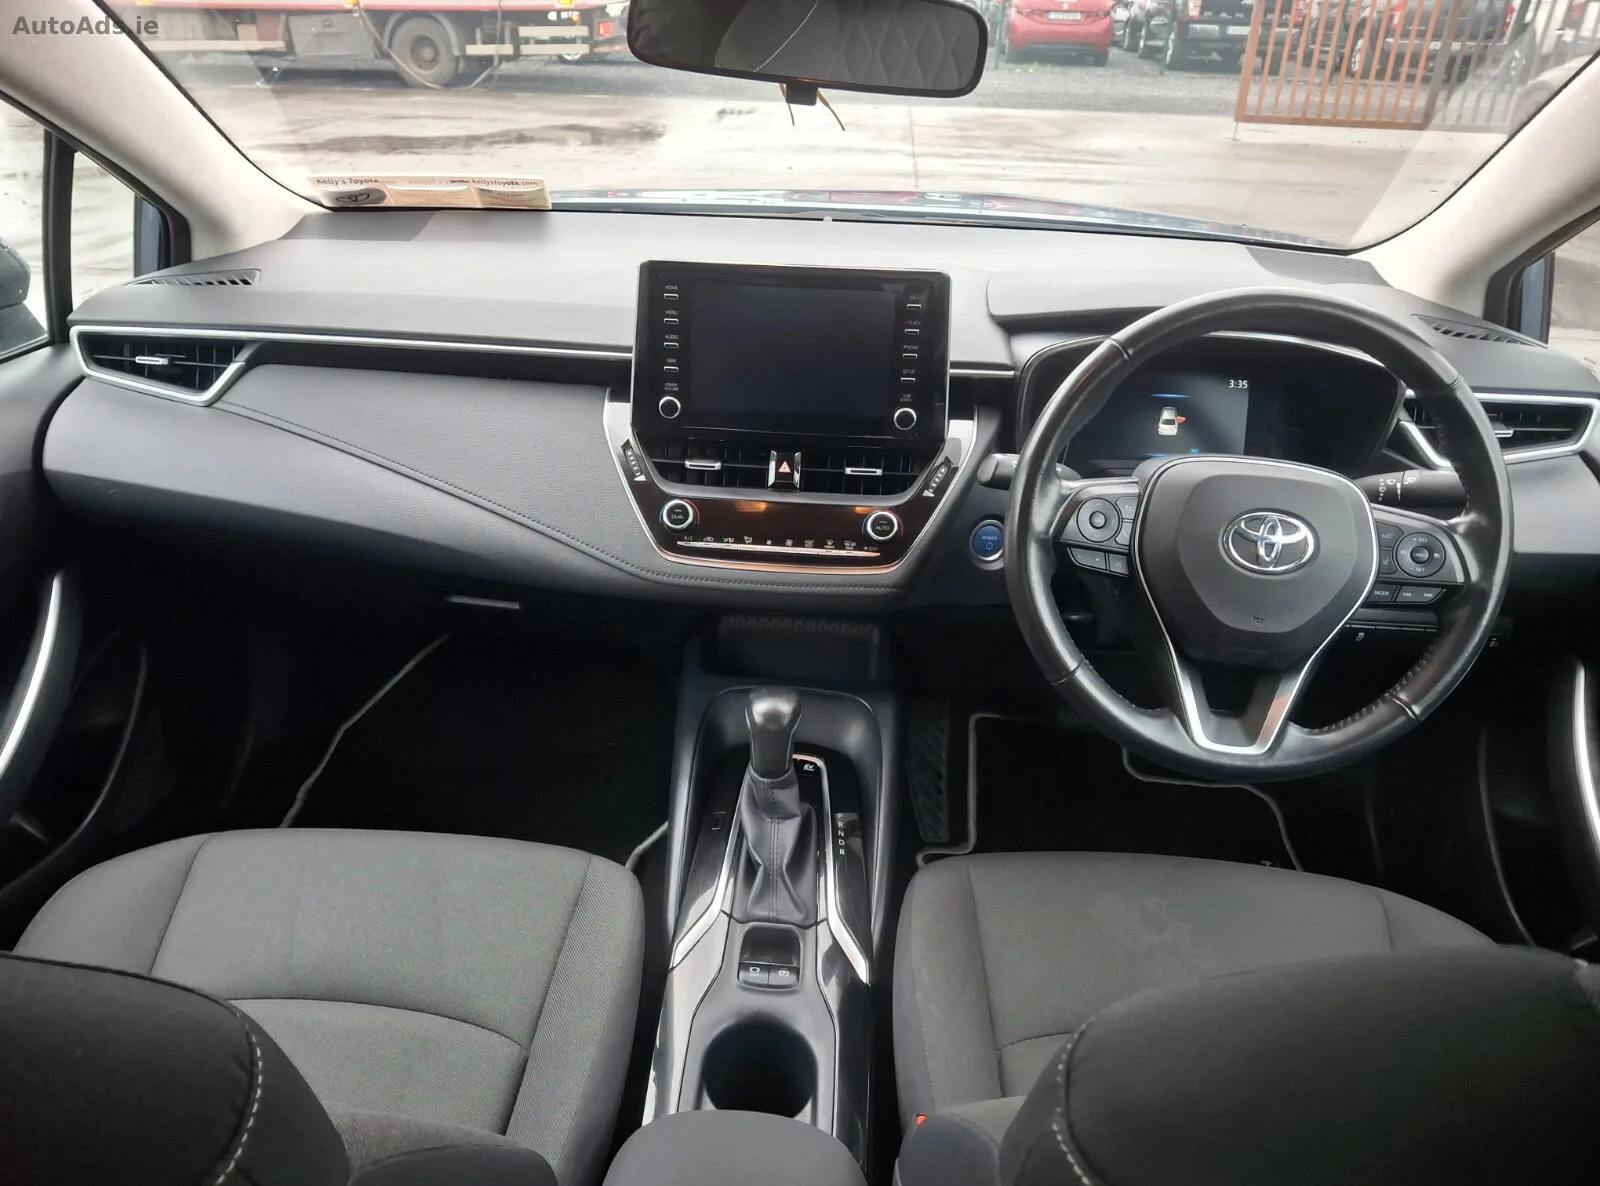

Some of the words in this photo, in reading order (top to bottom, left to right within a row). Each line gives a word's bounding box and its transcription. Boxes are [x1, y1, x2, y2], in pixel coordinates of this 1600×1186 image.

[316, 178, 346, 186] Kelly's
[348, 178, 379, 186] Toyota
[1228, 379, 1248, 389] 3:35
